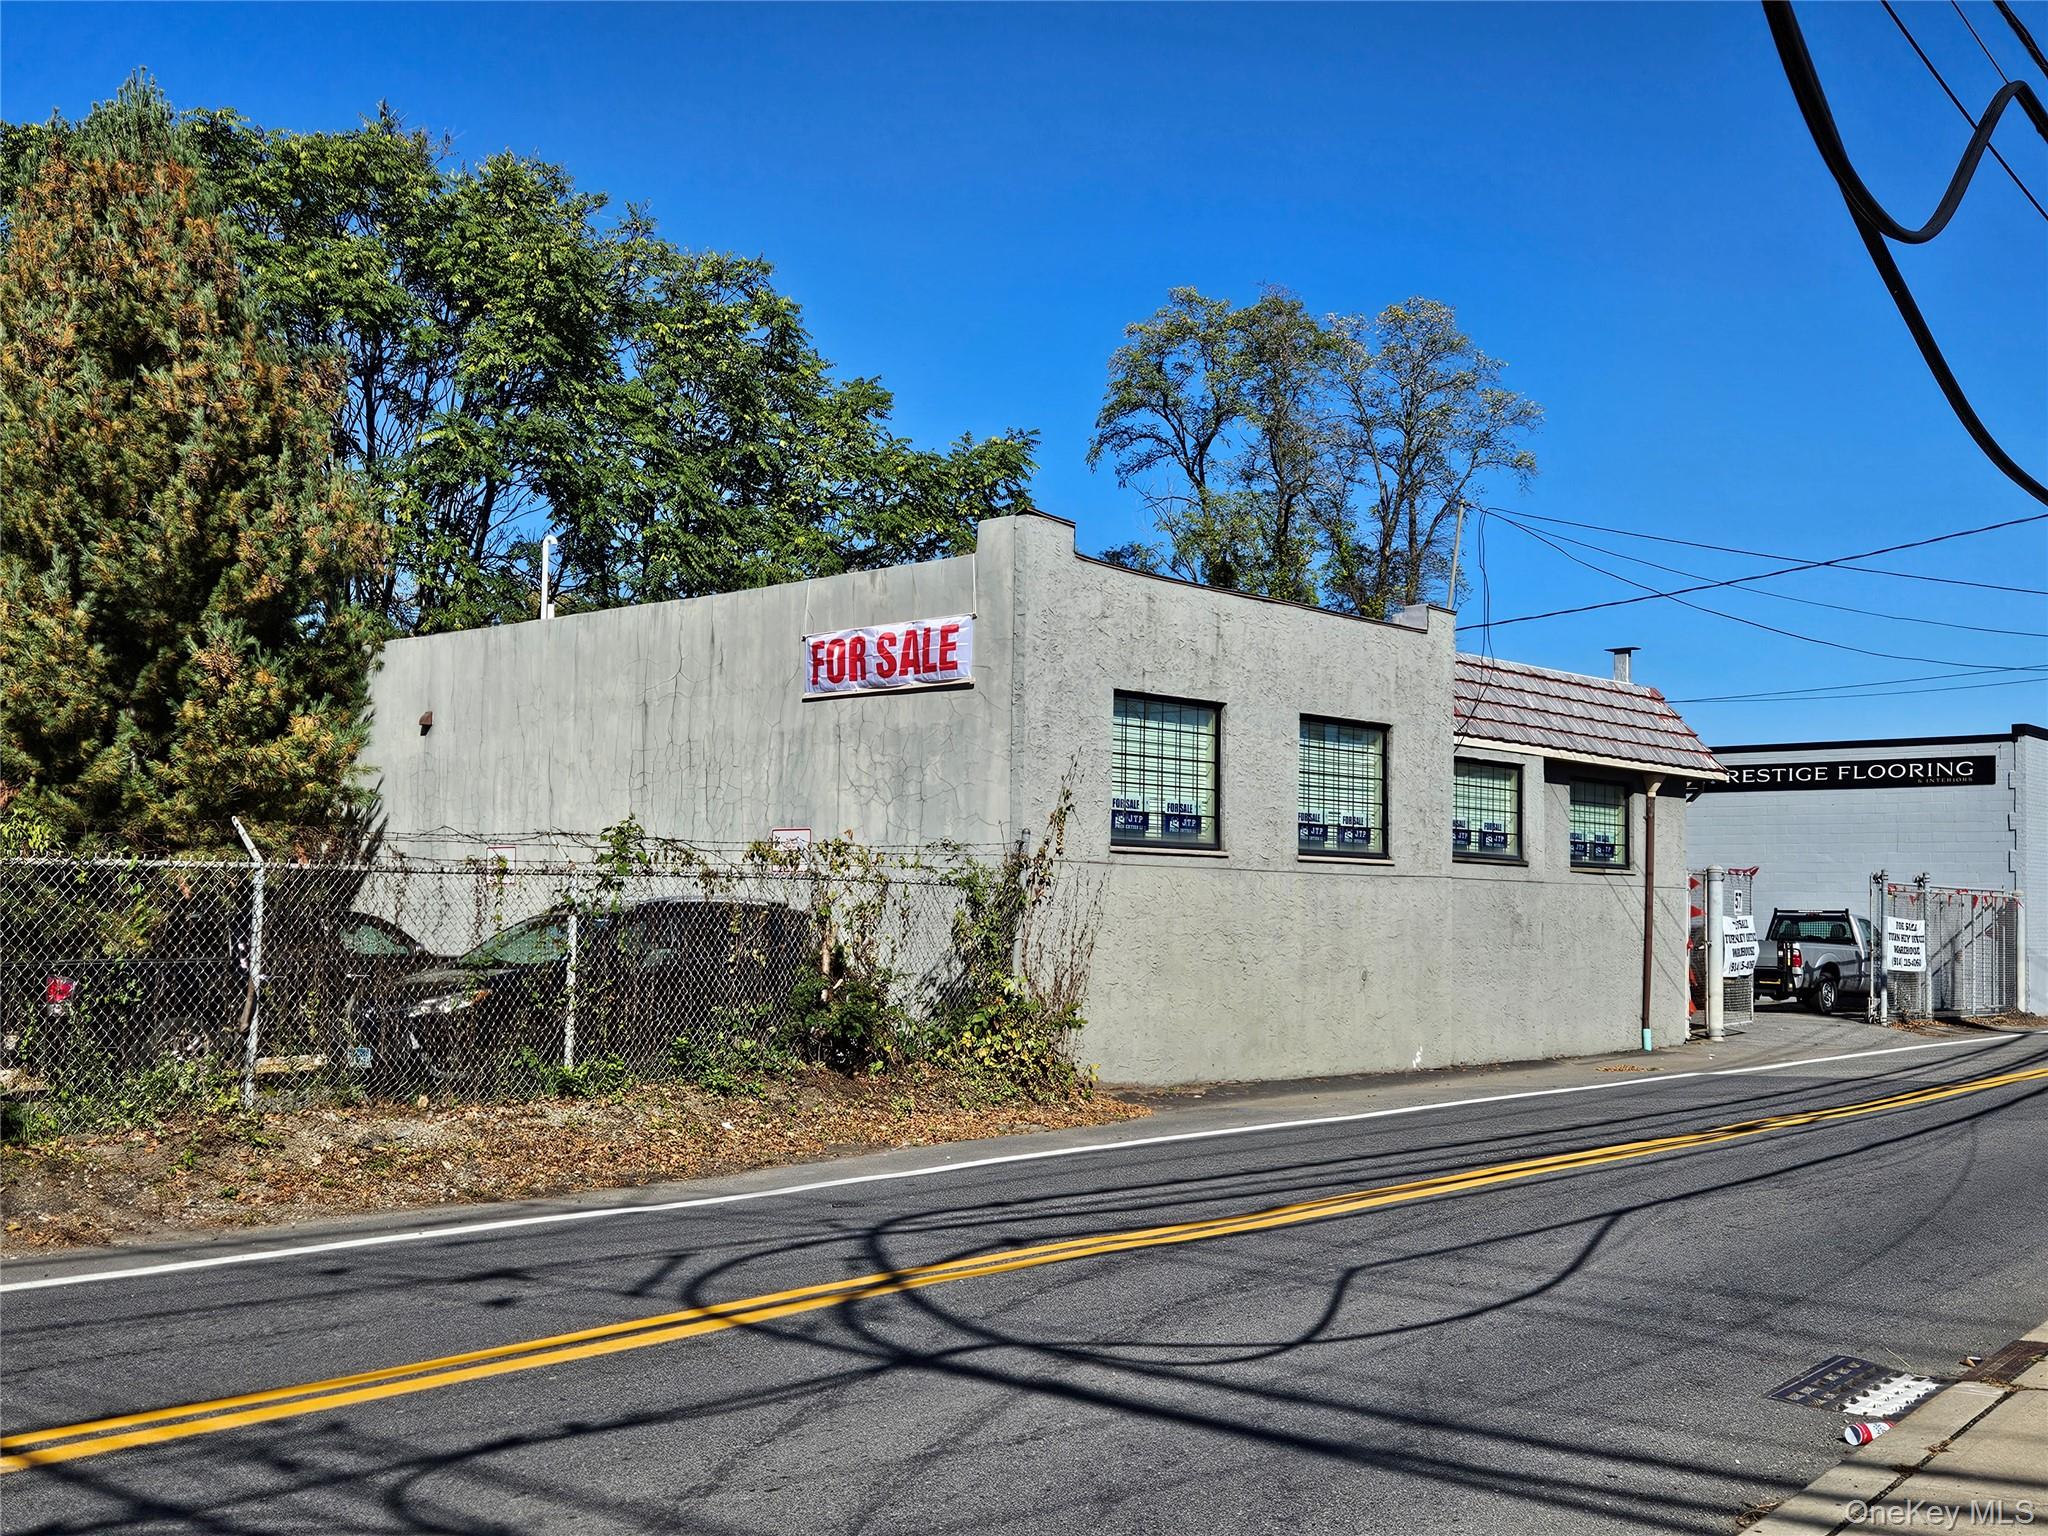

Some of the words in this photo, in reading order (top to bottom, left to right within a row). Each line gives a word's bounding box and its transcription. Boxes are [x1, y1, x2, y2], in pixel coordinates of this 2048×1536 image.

[811, 636, 866, 685] FOR
[876, 624, 960, 679] SALE
[1726, 767, 1829, 783] RESTIGE
[1838, 761, 1974, 780] FLOORING
[1112, 798, 1125, 808] FOR
[1126, 799, 1140, 809] SALE
[1167, 802, 1179, 812] FOR
[1180, 804, 1193, 813] SALE
[1128, 814, 1144, 823] JTP
[1181, 818, 1197, 826] JTP
[1309, 813, 1320, 822] SALE
[1310, 827, 1323, 835] JTP
[1354, 830, 1367, 838] JTP
